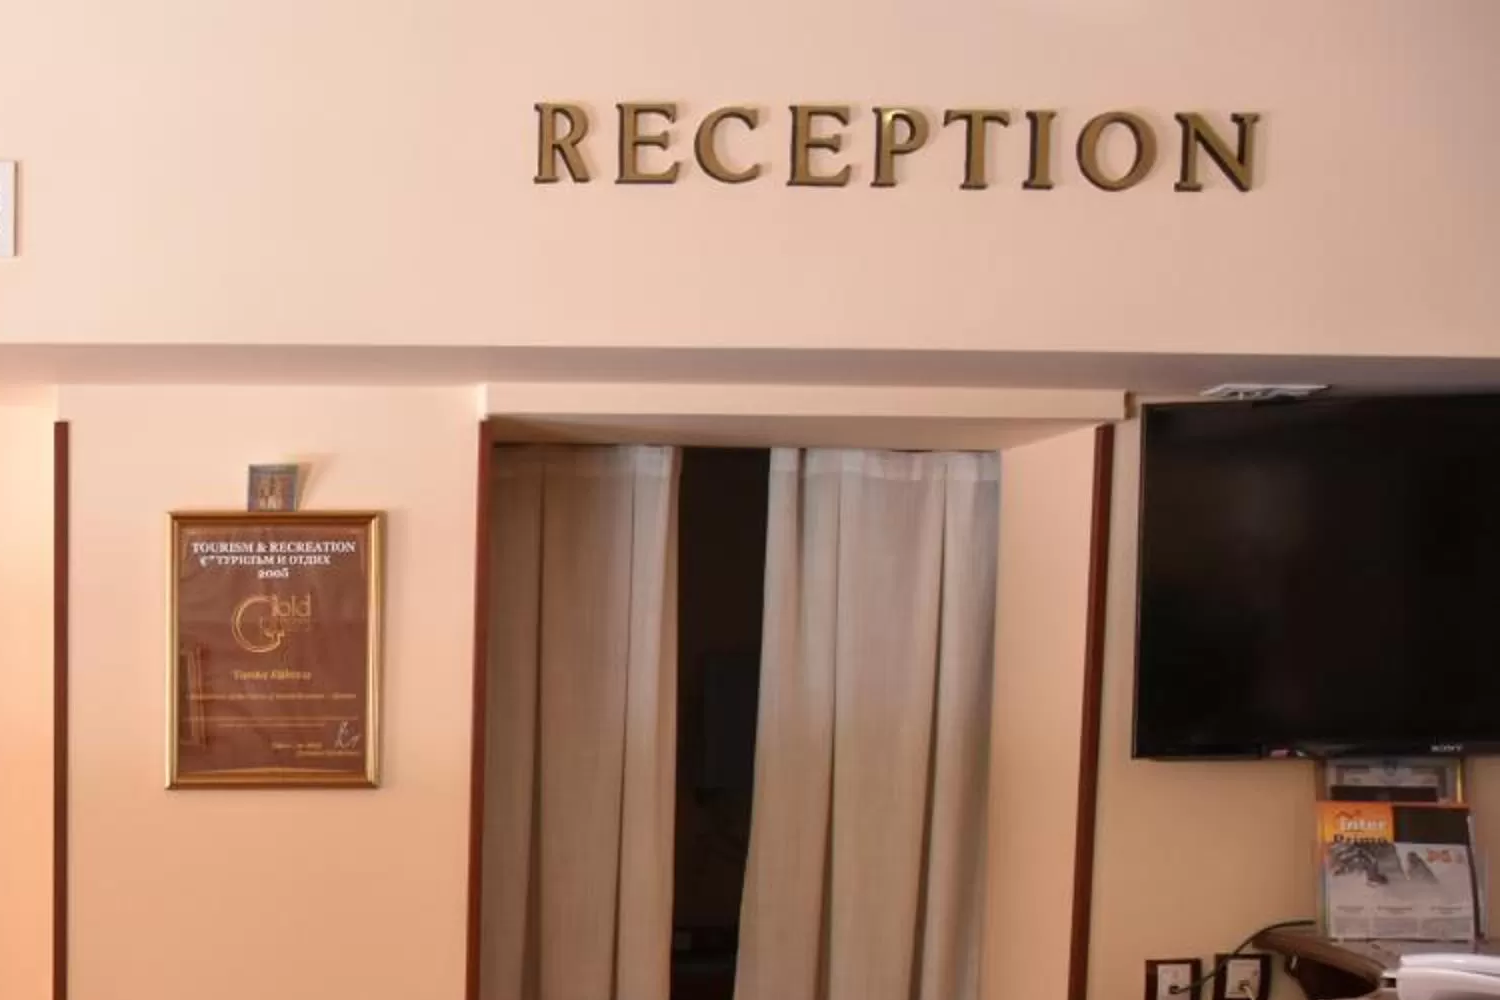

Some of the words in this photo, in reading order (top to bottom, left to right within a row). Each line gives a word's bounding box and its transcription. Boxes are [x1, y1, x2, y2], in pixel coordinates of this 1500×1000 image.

[533, 102, 1260, 192] RECEPTION
[191, 541, 254, 553] TOURISM
[256, 541, 269, 553] &
[270, 541, 357, 553] RECREATION
